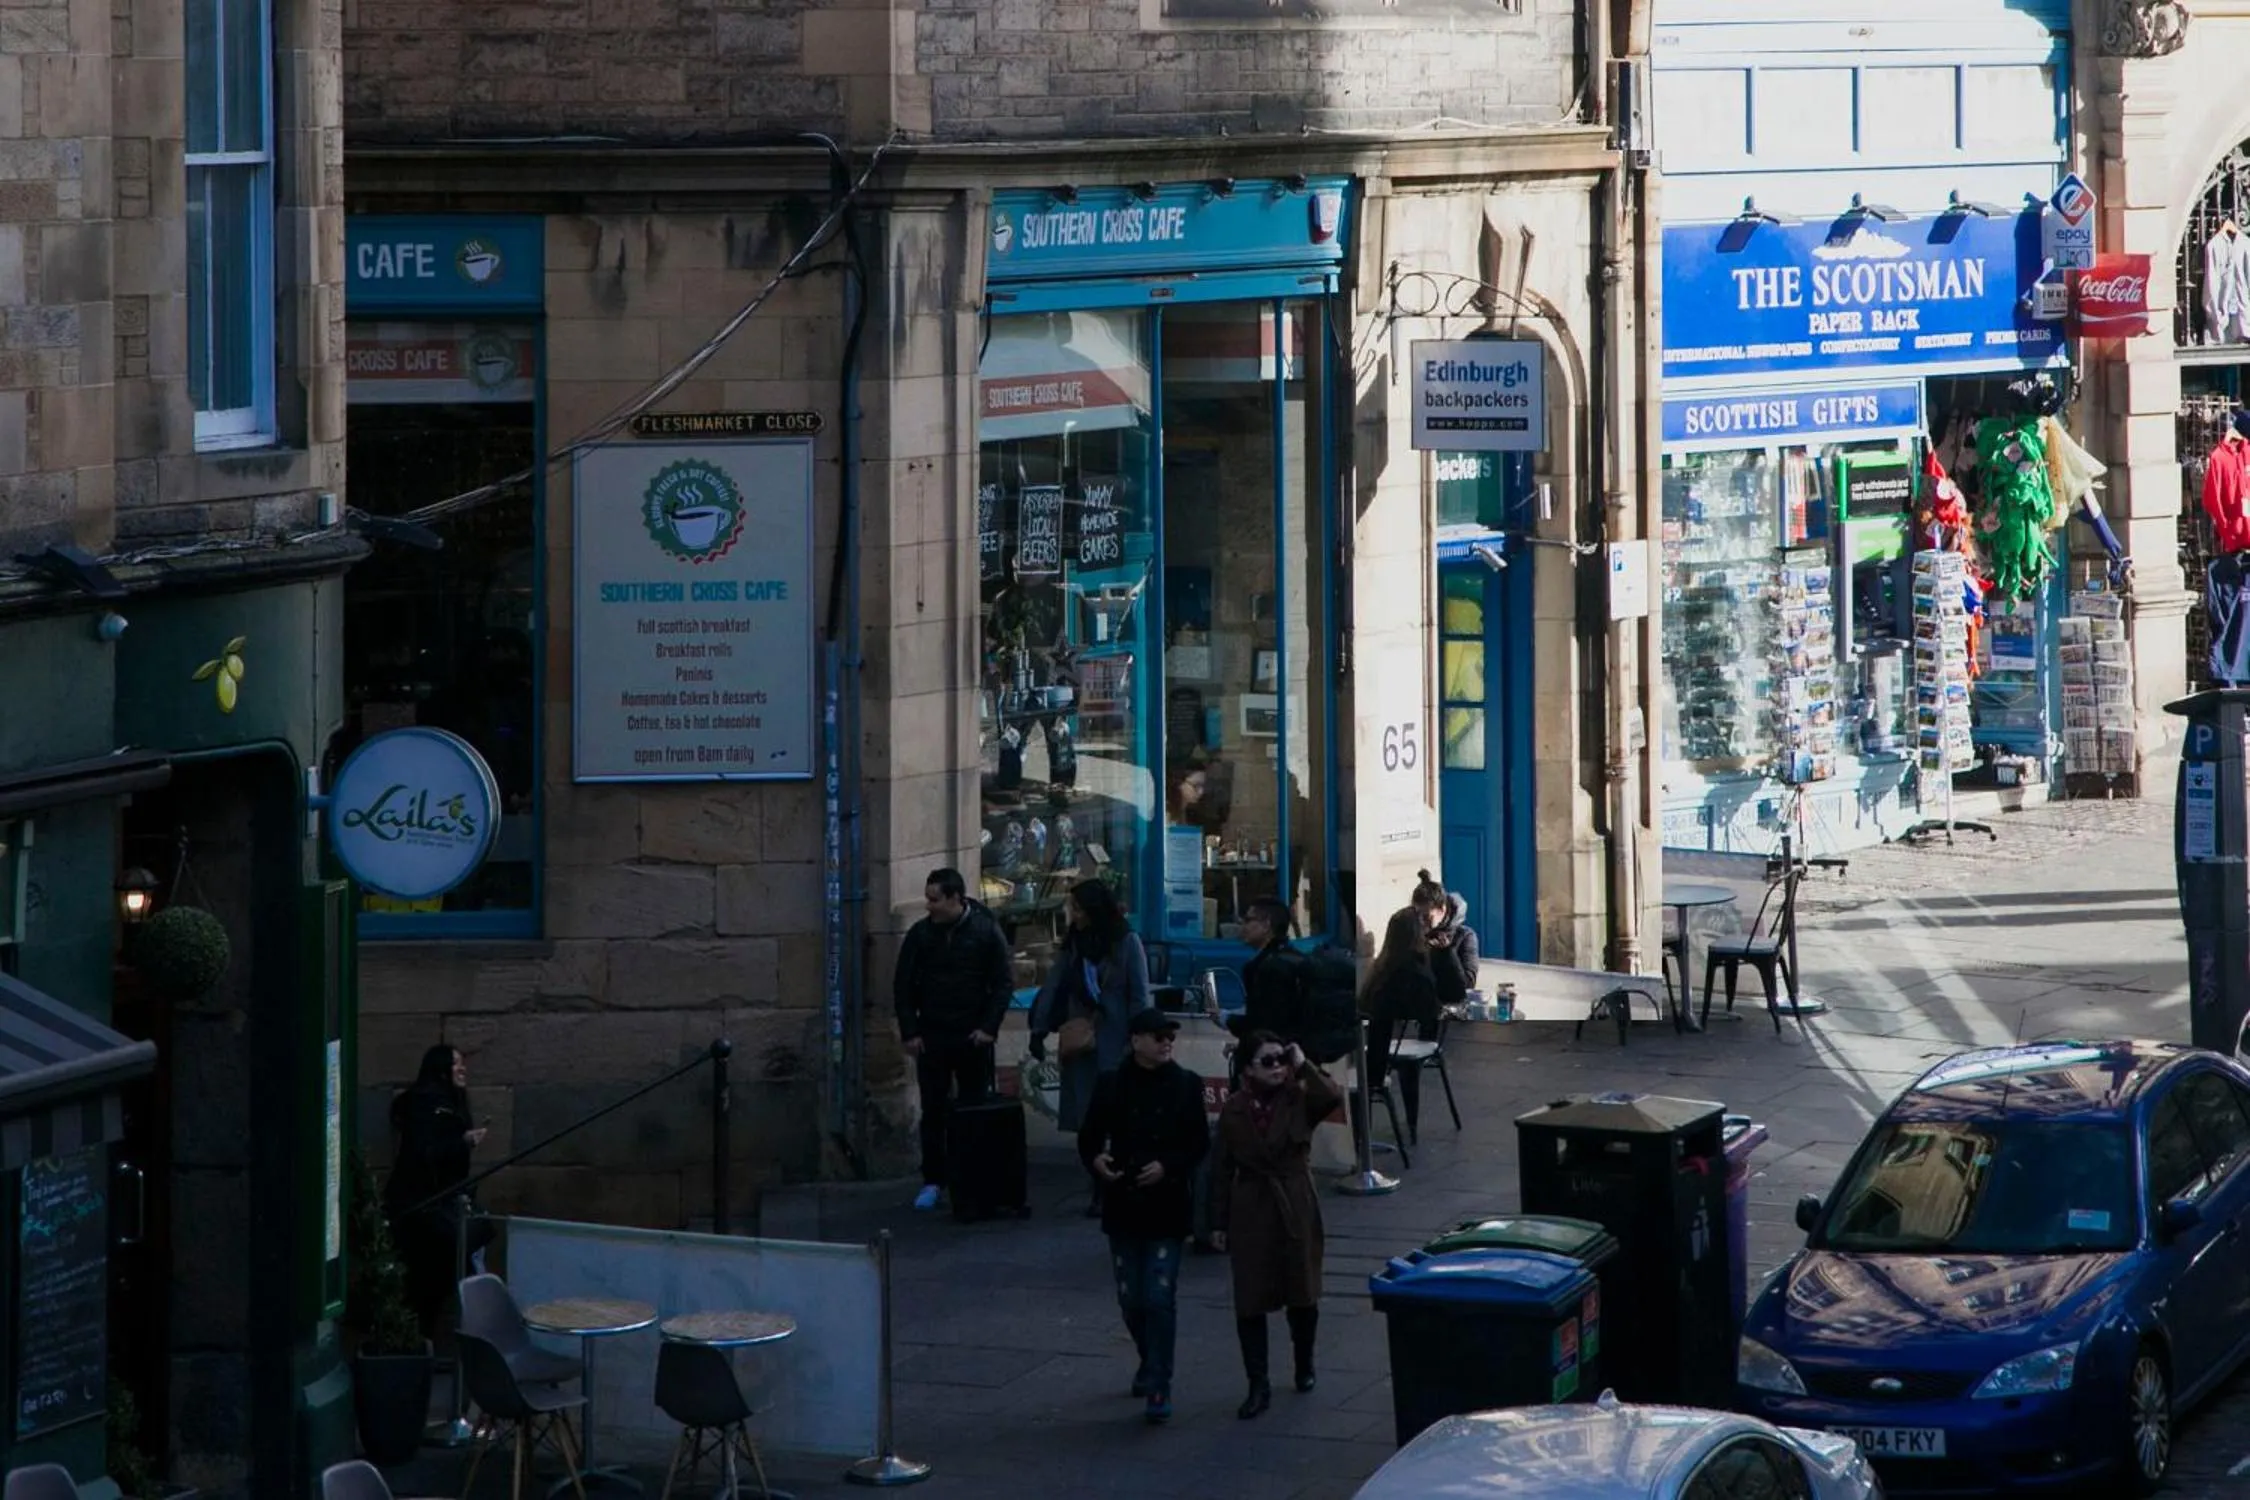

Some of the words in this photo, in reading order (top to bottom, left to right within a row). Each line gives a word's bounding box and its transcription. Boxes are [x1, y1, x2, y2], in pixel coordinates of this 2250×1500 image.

[1022, 211, 1098, 248] SOUTHERN
[1102, 207, 1143, 243] CROSS
[1148, 206, 1187, 241] CAFE
[2055, 227, 2091, 243] epay
[356, 242, 436, 280] CAFE
[1732, 265, 1802, 310] THE
[1812, 259, 1985, 306] SCOTSMAN
[1809, 310, 1864, 335] PAPER
[1871, 308, 1920, 331] RACK
[1662, 346, 1746, 363] INTERNATIONAL
[1745, 341, 1813, 358] NEWSPAPERS
[1820, 336, 1901, 354] CONFECTIONERY
[2019, 329, 2051, 342] CARDS
[348, 350, 397, 371] CROSS
[403, 349, 450, 371] CAFE
[1424, 360, 1529, 388] Edinburgh
[989, 386, 1032, 409] SOUTHERN
[1034, 383, 1060, 404] CROSS
[1061, 381, 1084, 404] CAFE
[1424, 391, 1530, 411] backpackers
[641, 415, 757, 431] FLESHMARKET
[765, 413, 817, 430] CLOSE
[1685, 400, 1799, 434] SCOTTISH
[1812, 395, 1879, 425] GIFTS
[1022, 538, 1057, 565] BEERS
[601, 583, 684, 602] SOUTHERN
[691, 581, 737, 601] CROSS
[745, 581, 788, 600] CAFE
[657, 619, 700, 633] scottish
[701, 618, 750, 633] breakfast
[656, 643, 705, 658] Breakfast
[708, 643, 732, 658] rolls
[676, 666, 713, 682] Paninis
[621, 691, 677, 706] Homemade
[722, 689, 767, 705] desserts
[693, 714, 710, 729] hot
[712, 714, 761, 729] chocolate
[1383, 722, 1416, 771] 65
[2194, 724, 2214, 755] P
[634, 748, 662, 764] open
[665, 746, 694, 761] from
[725, 744, 754, 763] daily
[1895, 1431, 1935, 1451] FKY
